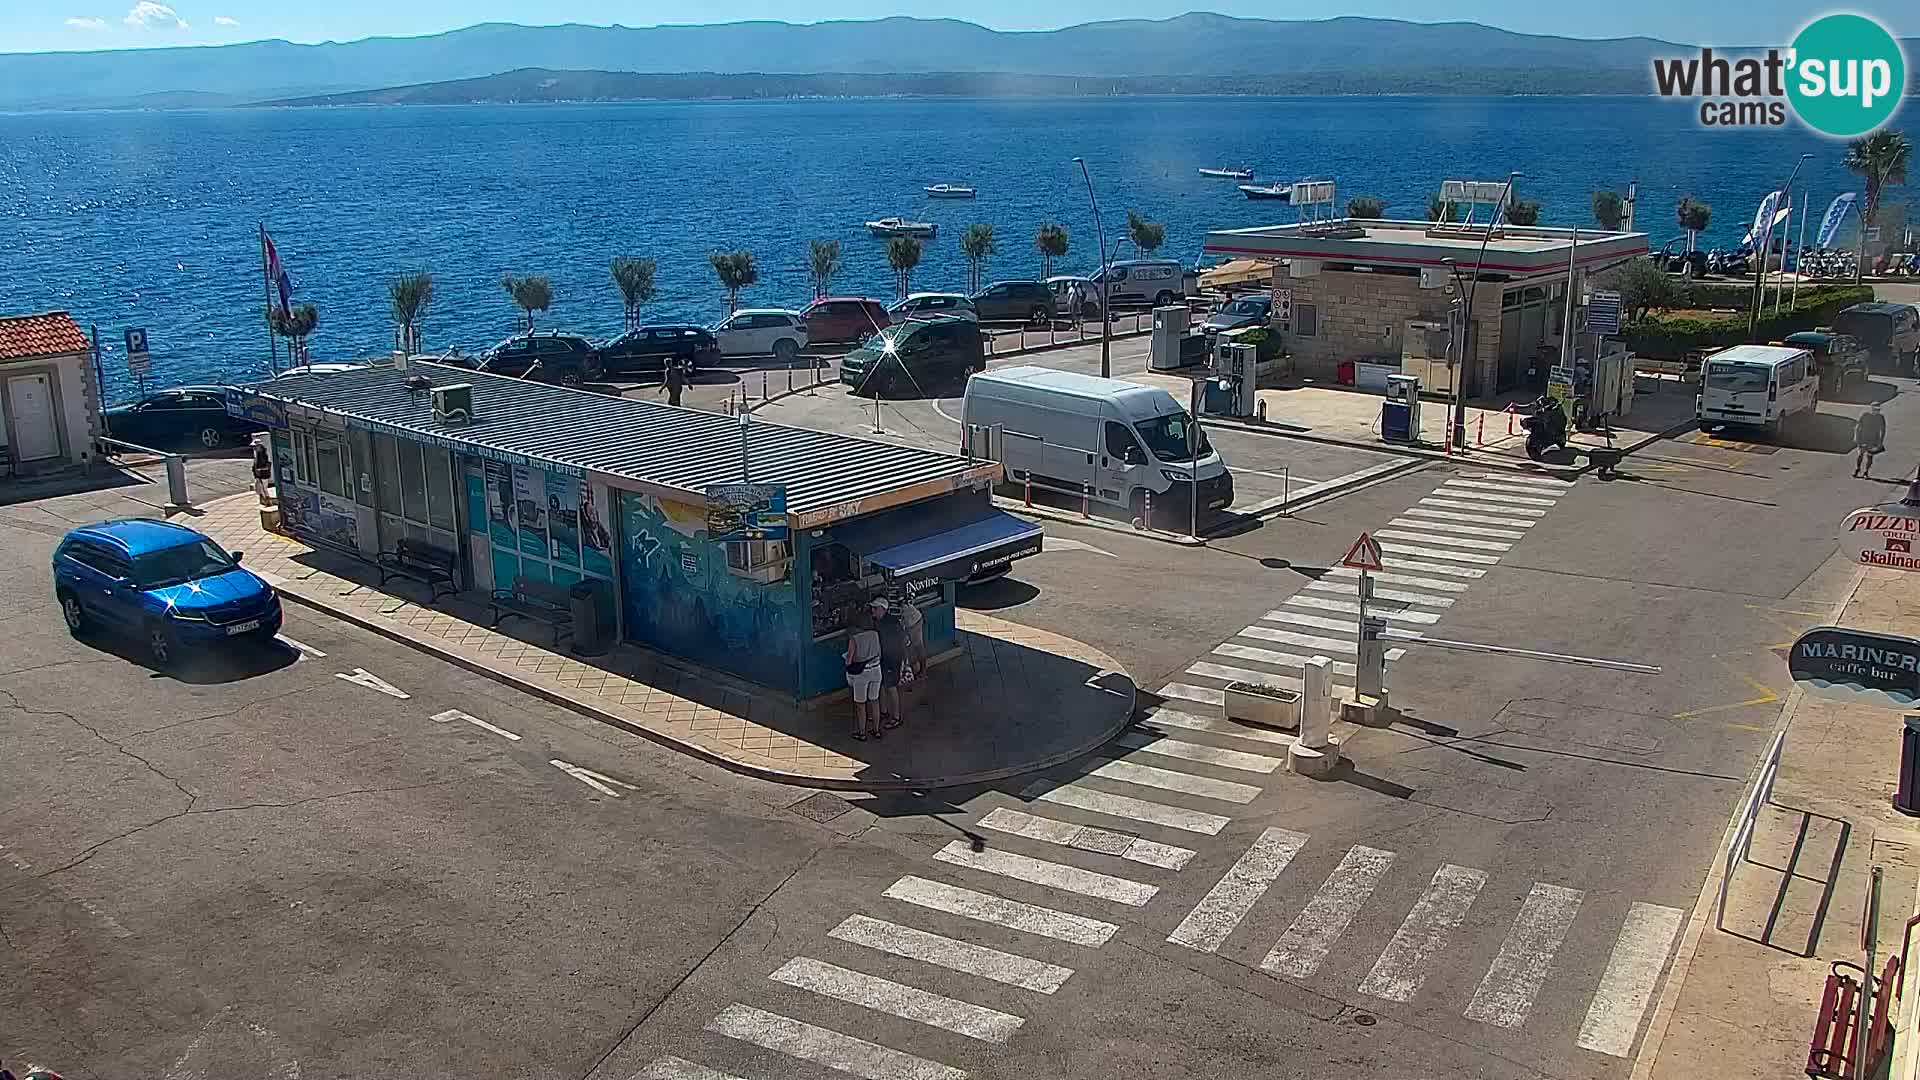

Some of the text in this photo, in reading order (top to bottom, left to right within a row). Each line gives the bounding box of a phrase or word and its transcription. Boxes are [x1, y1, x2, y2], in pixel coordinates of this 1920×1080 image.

[130, 331, 142, 350] P
[478, 447, 493, 458] BUS
[494, 450, 526, 465] STATION
[528, 458, 554, 471] TICKET
[555, 464, 584, 478] OFFICE
[1848, 515, 1920, 534] PIZZE
[982, 559, 994, 569] YOUR
[1801, 642, 1920, 673] MARINER
[1829, 662, 1897, 681] caffe bar
